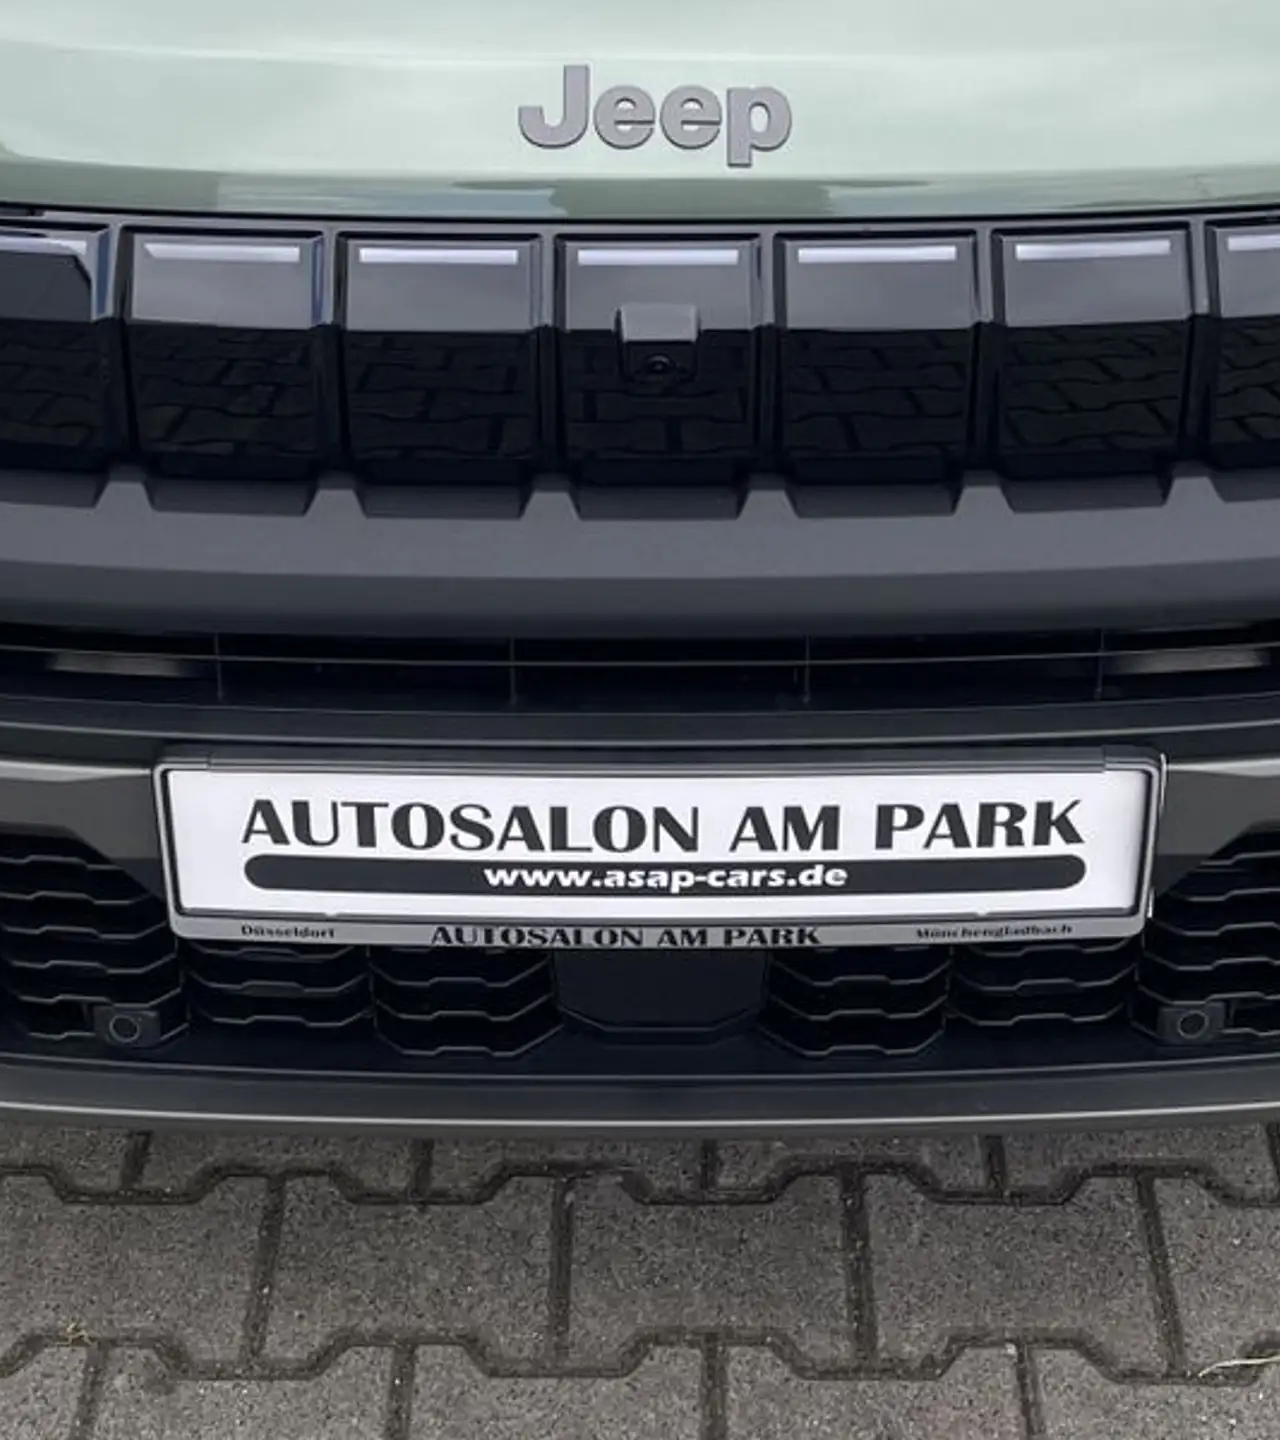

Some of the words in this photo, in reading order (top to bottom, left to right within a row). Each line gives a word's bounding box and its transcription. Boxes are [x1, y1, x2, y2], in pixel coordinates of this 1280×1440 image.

[517, 64, 793, 168] Jeep
[240, 798, 700, 853] AUTOSALON
[729, 805, 841, 852] AM
[874, 799, 1085, 850] PARK
[483, 863, 849, 894] www.asap-cars.de
[430, 925, 644, 947] AUTOSALON
[656, 926, 708, 947] AM
[722, 925, 822, 947] PARK
